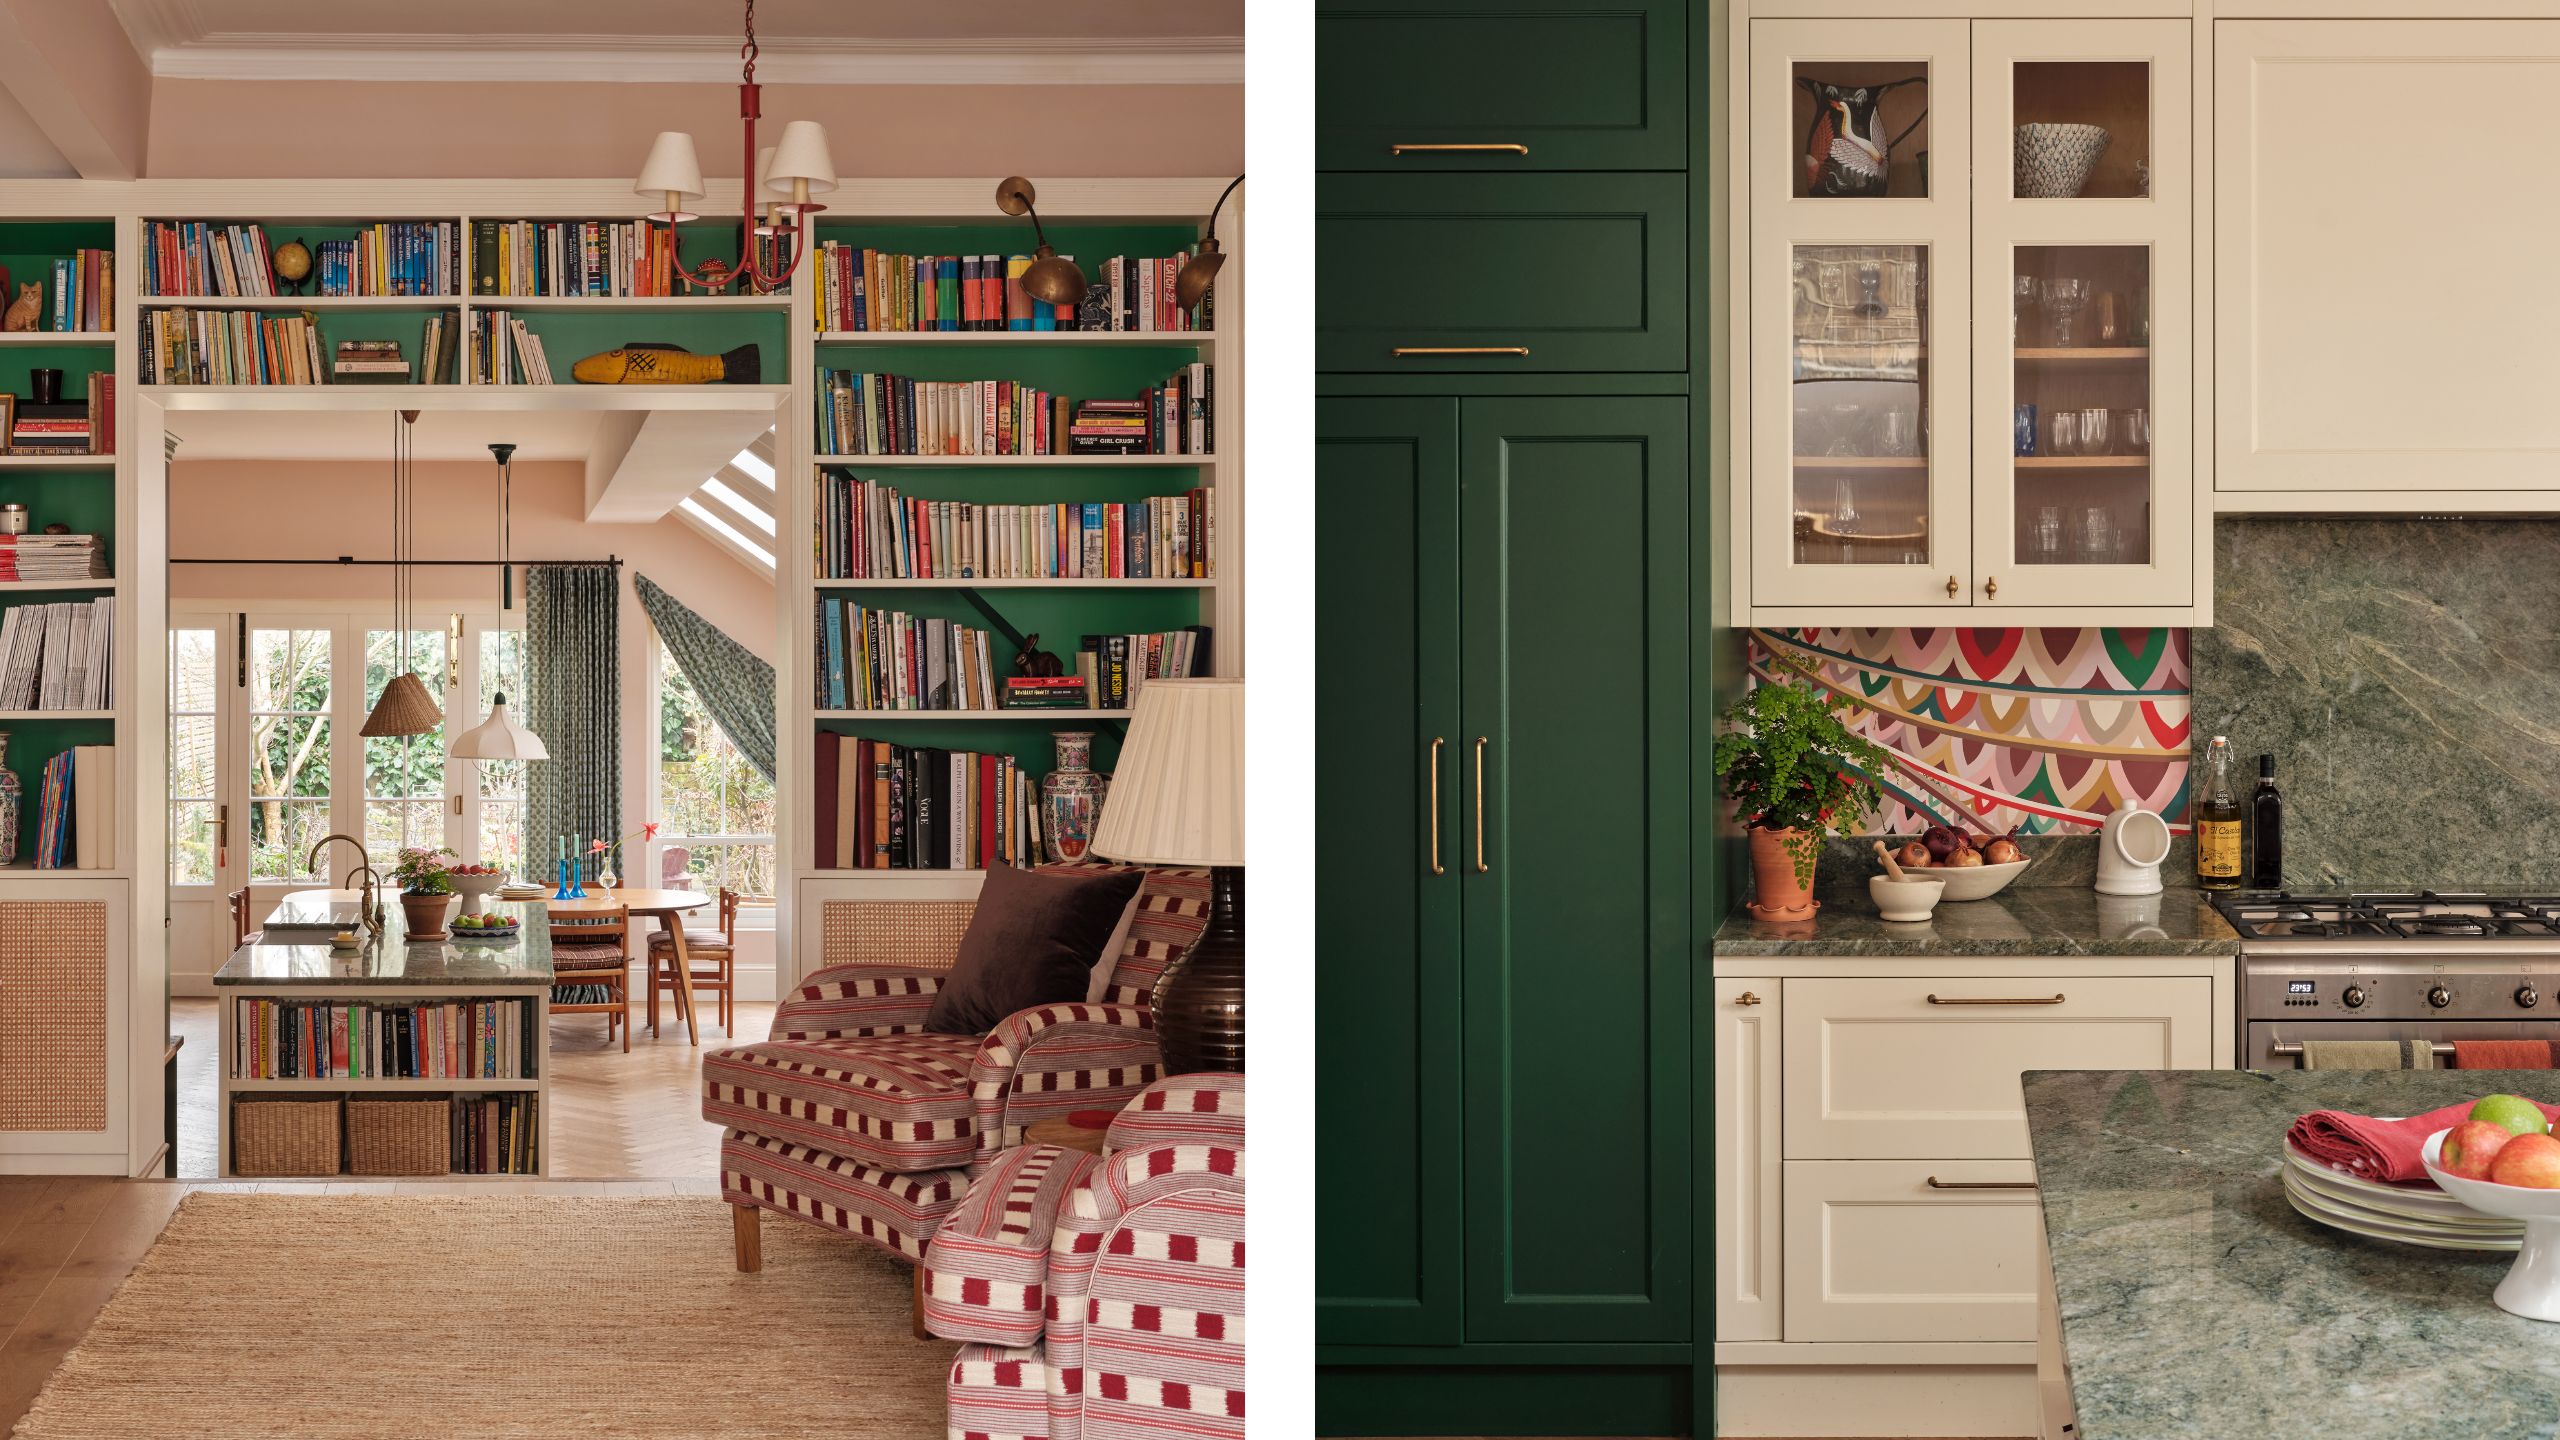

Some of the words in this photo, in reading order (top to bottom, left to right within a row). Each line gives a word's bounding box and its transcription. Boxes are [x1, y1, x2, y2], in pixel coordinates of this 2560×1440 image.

[452, 240, 460, 252] DOG
[1140, 275, 1152, 309] Sapiens
[1166, 264, 1175, 303] CATCH-22
[986, 383, 995, 413] WILLIAM
[1179, 512, 1184, 520] 3
[1112, 662, 1122, 672] JO
[920, 798, 932, 825] VOGUE
[956, 824, 962, 833] OF
